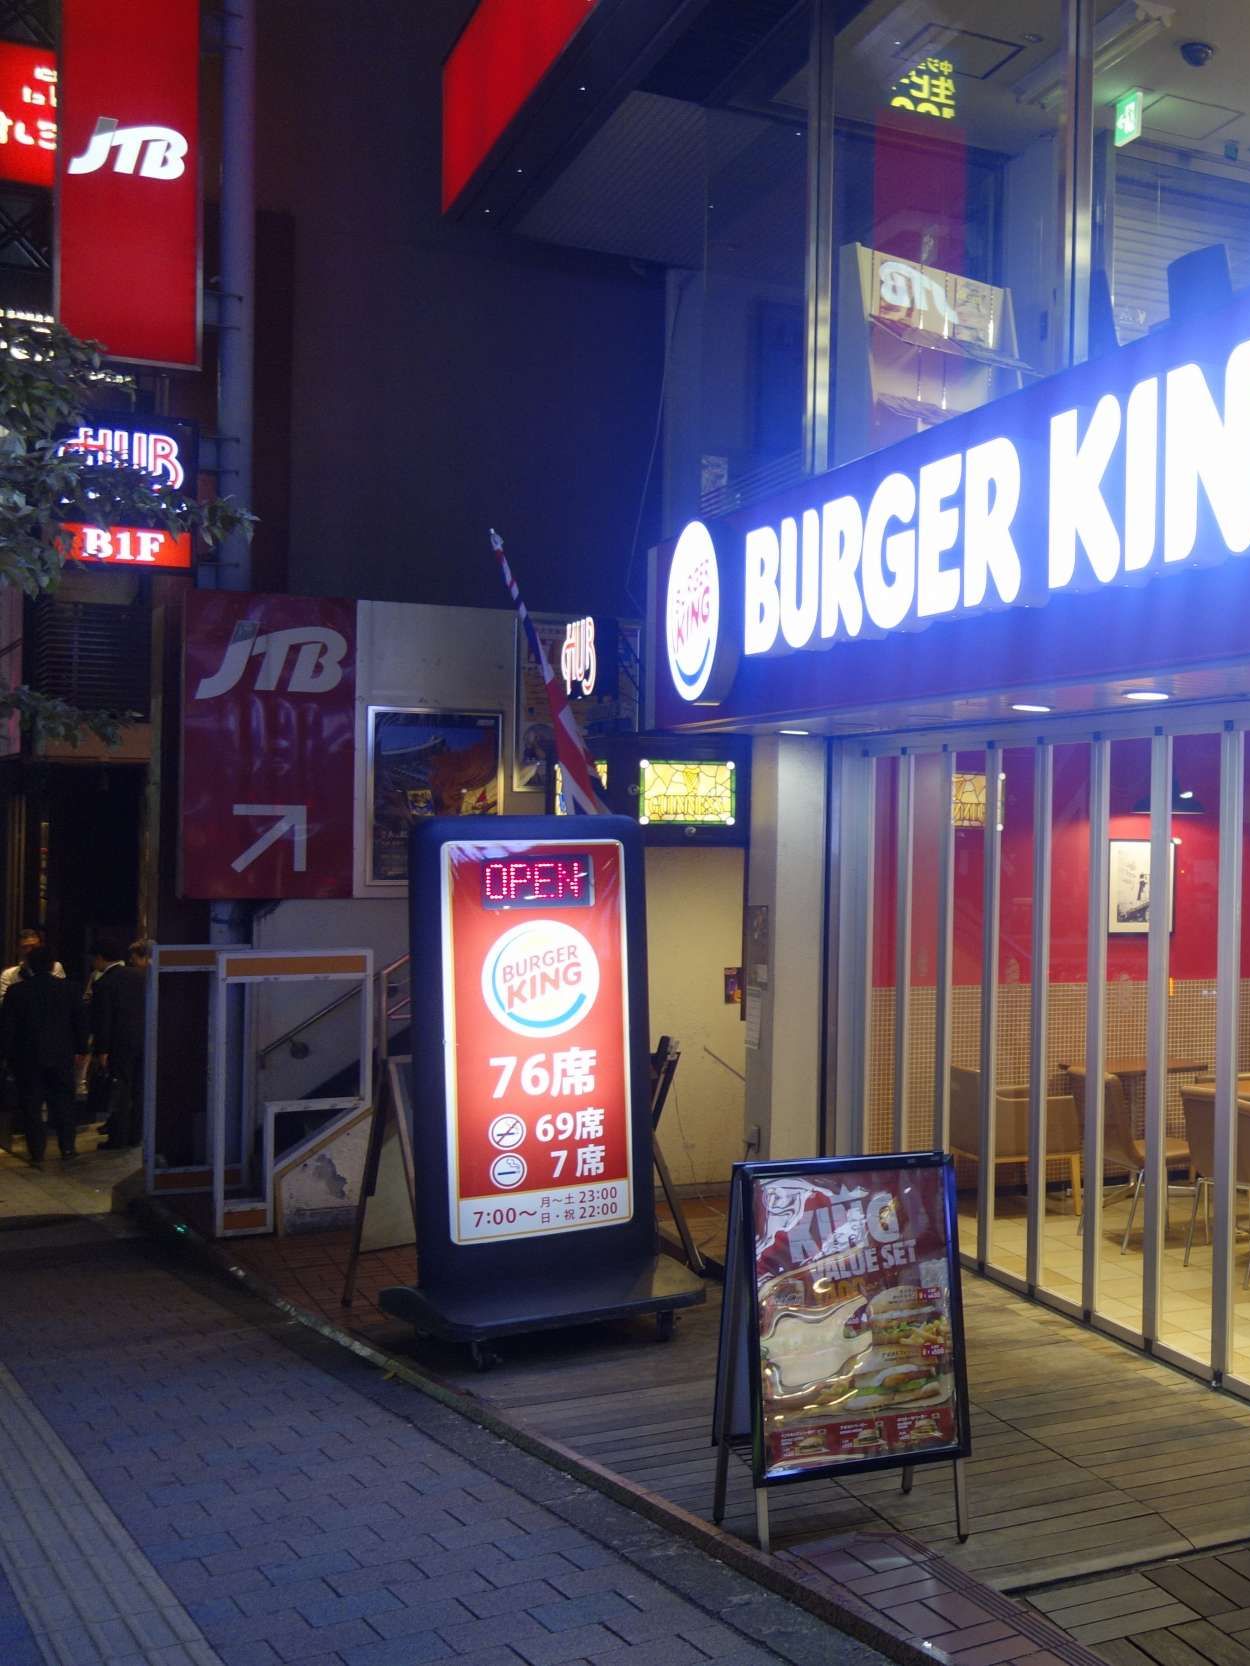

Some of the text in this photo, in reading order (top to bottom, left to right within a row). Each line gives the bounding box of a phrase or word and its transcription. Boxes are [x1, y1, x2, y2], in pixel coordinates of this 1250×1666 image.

[67, 116, 189, 181] JTB
[82, 527, 166, 562] B1F
[744, 436, 1021, 656] BURGER
[194, 620, 348, 700] JTB
[560, 616, 597, 697] HUB
[485, 862, 579, 900] OPEN
[502, 944, 579, 985] BURGER
[507, 962, 582, 1010] KING
[489, 1046, 597, 1099] 76席
[535, 1106, 605, 1142] 69席
[578, 1186, 618, 1204] 23:00
[578, 1201, 618, 1219] 22:00
[881, 1239, 916, 1269] SET
